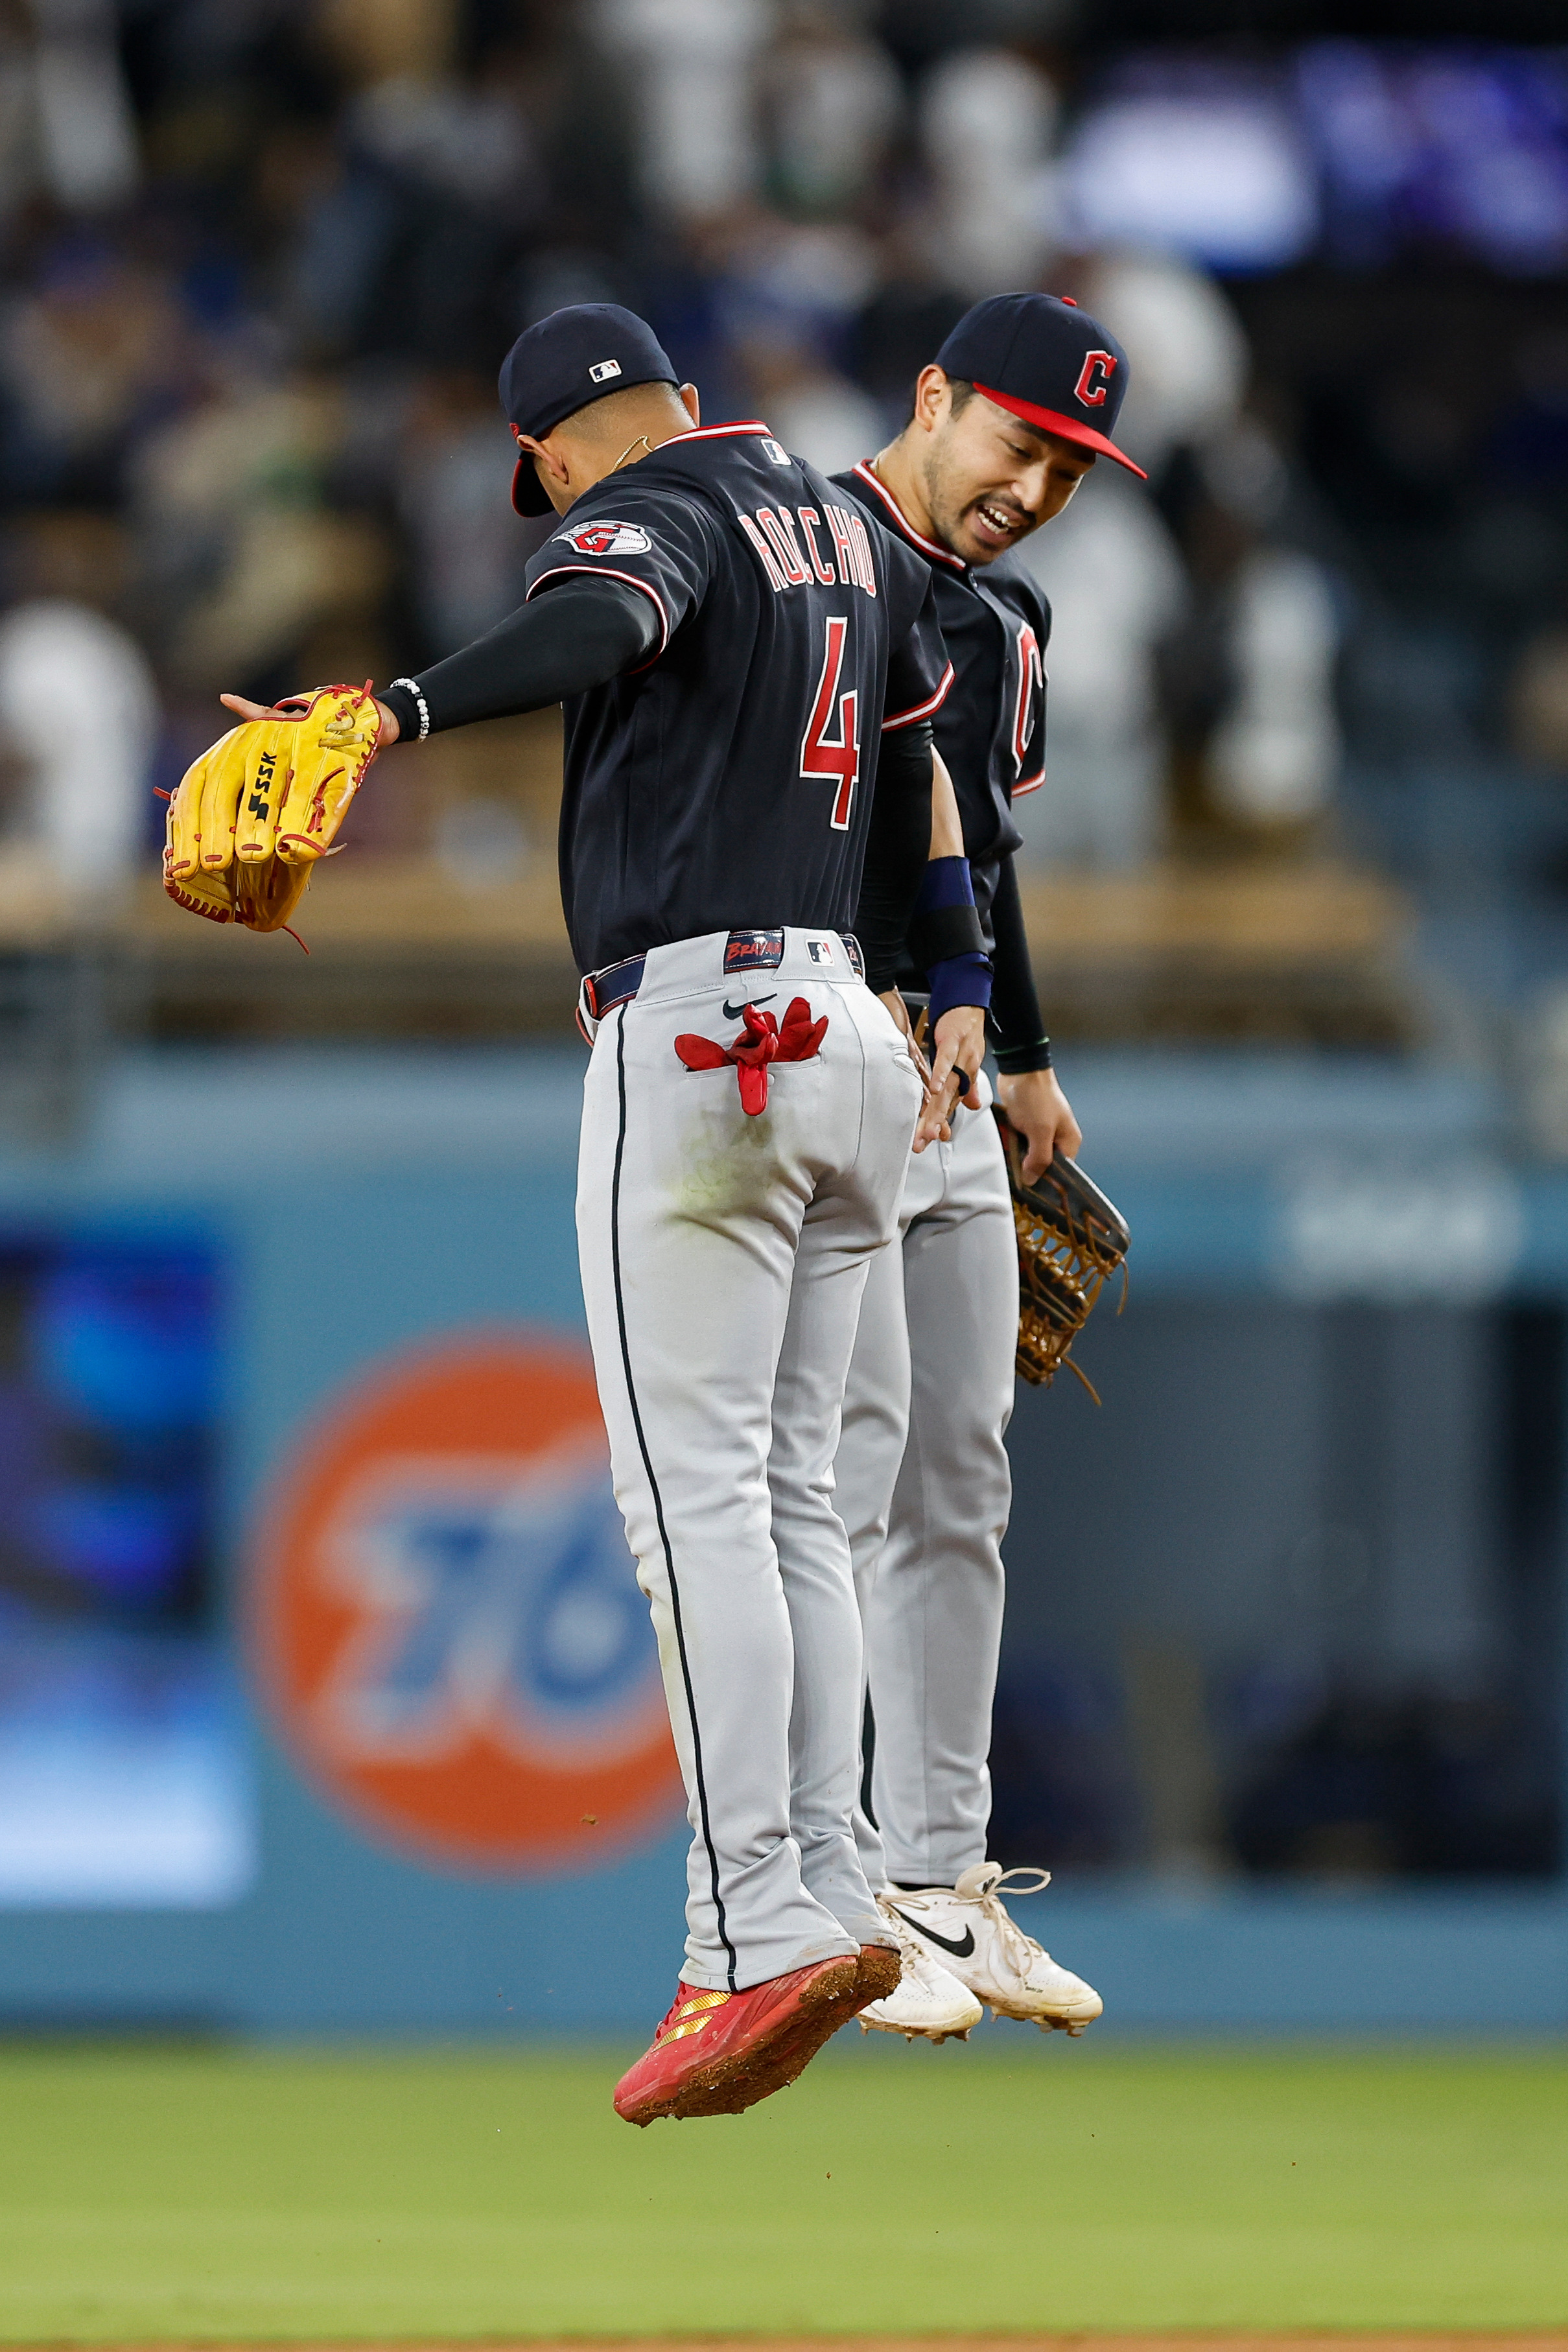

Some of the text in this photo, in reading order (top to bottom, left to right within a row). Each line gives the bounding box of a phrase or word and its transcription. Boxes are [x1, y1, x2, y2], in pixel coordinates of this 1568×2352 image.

[1074, 350, 1117, 407] C
[738, 504, 877, 598] ROCCHIO
[800, 616, 861, 831] 4
[255, 750, 277, 794] SSK
[337, 1439, 656, 1744] 76
